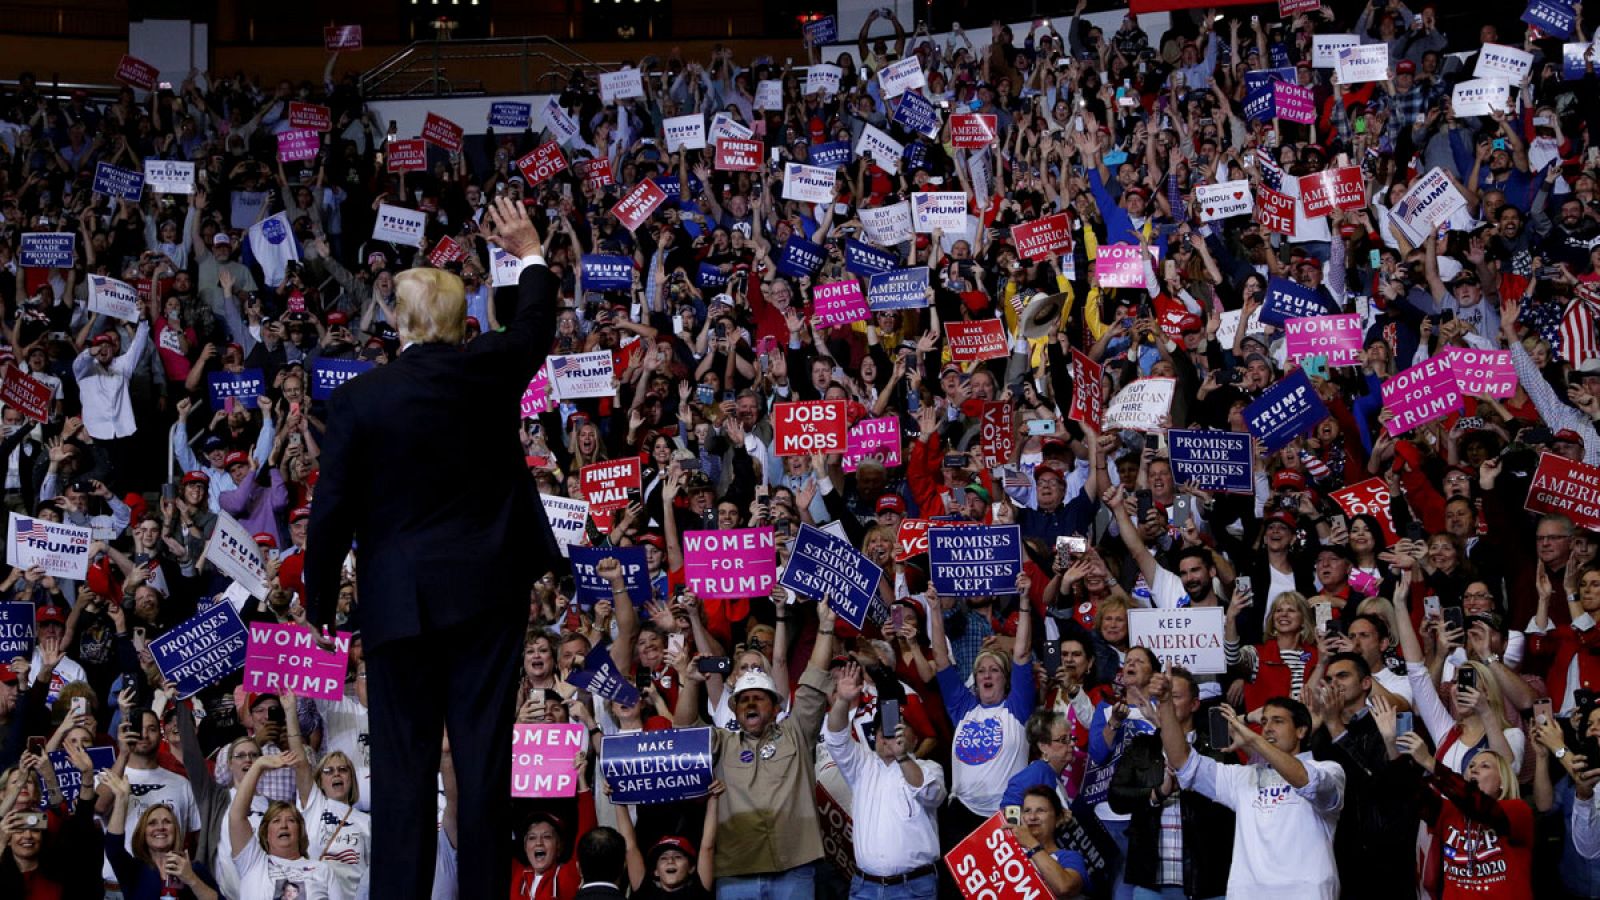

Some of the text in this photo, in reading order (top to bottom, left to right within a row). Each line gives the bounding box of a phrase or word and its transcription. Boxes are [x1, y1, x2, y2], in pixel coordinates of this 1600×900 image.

[1485, 53, 1527, 67] TRUMP
[1276, 85, 1314, 100] WOMEN
[1276, 106, 1312, 120] TRUMP
[278, 131, 318, 141] WOMEN
[666, 125, 701, 133] TRUMP
[953, 125, 995, 135] AMERICA
[723, 141, 757, 151] FINISH
[866, 134, 898, 158] TRUMP
[281, 148, 319, 161] TRUMP
[519, 144, 555, 169] GET OUT
[724, 156, 756, 166] WALL
[813, 149, 850, 160] TRUMP
[150, 168, 190, 177] TRUMP
[529, 156, 563, 182] VOTE
[799, 177, 834, 188] TRUMP
[618, 184, 649, 212] FINISH
[1303, 181, 1363, 203] AMERICA
[1411, 181, 1449, 216] TRUMP
[1271, 195, 1293, 209] OUT
[1336, 194, 1360, 205] AGAIN
[629, 195, 657, 221] WALL
[925, 206, 965, 215] TRUMP
[1219, 204, 1247, 213] TRUMP
[382, 215, 421, 228] TRUMP
[1033, 223, 1052, 233] MAKE
[1019, 229, 1069, 250] AMERICA
[789, 245, 823, 265] TRUMP
[1024, 241, 1068, 257] GREAT AGAIN
[1098, 248, 1139, 258] WOM
[852, 248, 894, 270] TRUMP
[1116, 262, 1135, 270] FOR
[585, 263, 631, 272] TRUMP
[1100, 273, 1142, 284] TRUM
[815, 284, 860, 299] WOMEN
[870, 282, 927, 295] AMERICA
[828, 299, 846, 308] FOR
[870, 294, 902, 303] STRONG
[1273, 291, 1328, 313] TRUMP
[819, 309, 866, 324] TRUMP
[963, 326, 983, 334] MAKE
[1287, 318, 1361, 334] WOMEN
[950, 334, 1005, 346] AMERICA
[1311, 337, 1336, 346] FOR
[955, 344, 1001, 354] GREAT AGAIN
[575, 354, 610, 363] VETERANS
[1292, 349, 1358, 365] TMP
[1449, 351, 1508, 364] WOME
[317, 369, 358, 380] TRUM
[565, 367, 612, 379] TRUMP
[1382, 357, 1450, 397] WOMEN
[1466, 369, 1494, 378] FOR
[213, 380, 260, 390] TRUMP
[1075, 359, 1087, 412] MOBS
[1128, 384, 1146, 393] BUY
[1459, 381, 1511, 394] RUMP
[1089, 370, 1101, 424] JOBS
[1405, 386, 1431, 403] FOR
[784, 405, 837, 422] JOBS
[1121, 403, 1143, 411] HIRE
[1252, 385, 1305, 428] TRUMP
[1393, 393, 1457, 428] TRUMP
[1260, 398, 1307, 432] PENCE
[801, 423, 818, 432] VS.
[851, 421, 895, 436] TRUM
[1002, 404, 1011, 460] GET OU
[784, 433, 837, 450] MOBS
[860, 440, 880, 448] FOR
[984, 408, 997, 468] VOTE
[1177, 437, 1243, 450] PROMISES
[1190, 449, 1229, 460] MADE
[586, 465, 632, 481] FINISH
[1178, 463, 1243, 475] PROMISES
[601, 480, 615, 488] THE
[1191, 475, 1227, 485] KEPT
[1567, 470, 1598, 485] MAKE
[1534, 474, 1600, 504] AMERI
[542, 499, 585, 512] VETERANS
[1536, 492, 1600, 518] GREAT AGA
[568, 512, 584, 520] FOR
[45, 525, 88, 538] VETERANS
[551, 519, 583, 531] UMP
[27, 537, 87, 555] TRUMP
[70, 537, 87, 545] FOR
[685, 532, 773, 551] WOMEN
[936, 535, 1010, 549] PROMISES
[826, 541, 859, 569] KEPT
[951, 549, 994, 561] MADE
[29, 556, 78, 570] AMERICA
[711, 559, 744, 569] FOR
[804, 543, 869, 590] PROMISES
[938, 564, 1012, 577] PROMISES
[690, 575, 772, 593] TRUMP
[815, 564, 852, 594] MADE
[953, 578, 993, 590] KEPT
[794, 570, 857, 617] PROMISES
[0, 623, 33, 637] RICA
[1159, 618, 1191, 629] KEEP
[159, 611, 228, 656] PROMISES
[0, 641, 28, 651] GAIN
[180, 631, 221, 659] MADE
[1135, 634, 1221, 648] AMERICA
[173, 636, 244, 682] PROMISES
[278, 654, 312, 668] FOR
[1158, 653, 1197, 666] GREAT
[195, 658, 233, 683] KEPT
[251, 671, 338, 693] TRUMP
[638, 741, 673, 752] MAKE
[957, 735, 1003, 748] FORCE
[607, 753, 707, 777] AMERICA
[515, 774, 570, 791] UMP
[618, 773, 701, 792] SAFE AGAIN
[818, 801, 853, 843] JOB
[1073, 817, 1105, 870] TRUMP
[986, 828, 1040, 900] MOBS
[1476, 859, 1506, 877] 2020
[957, 854, 998, 900] OBS
